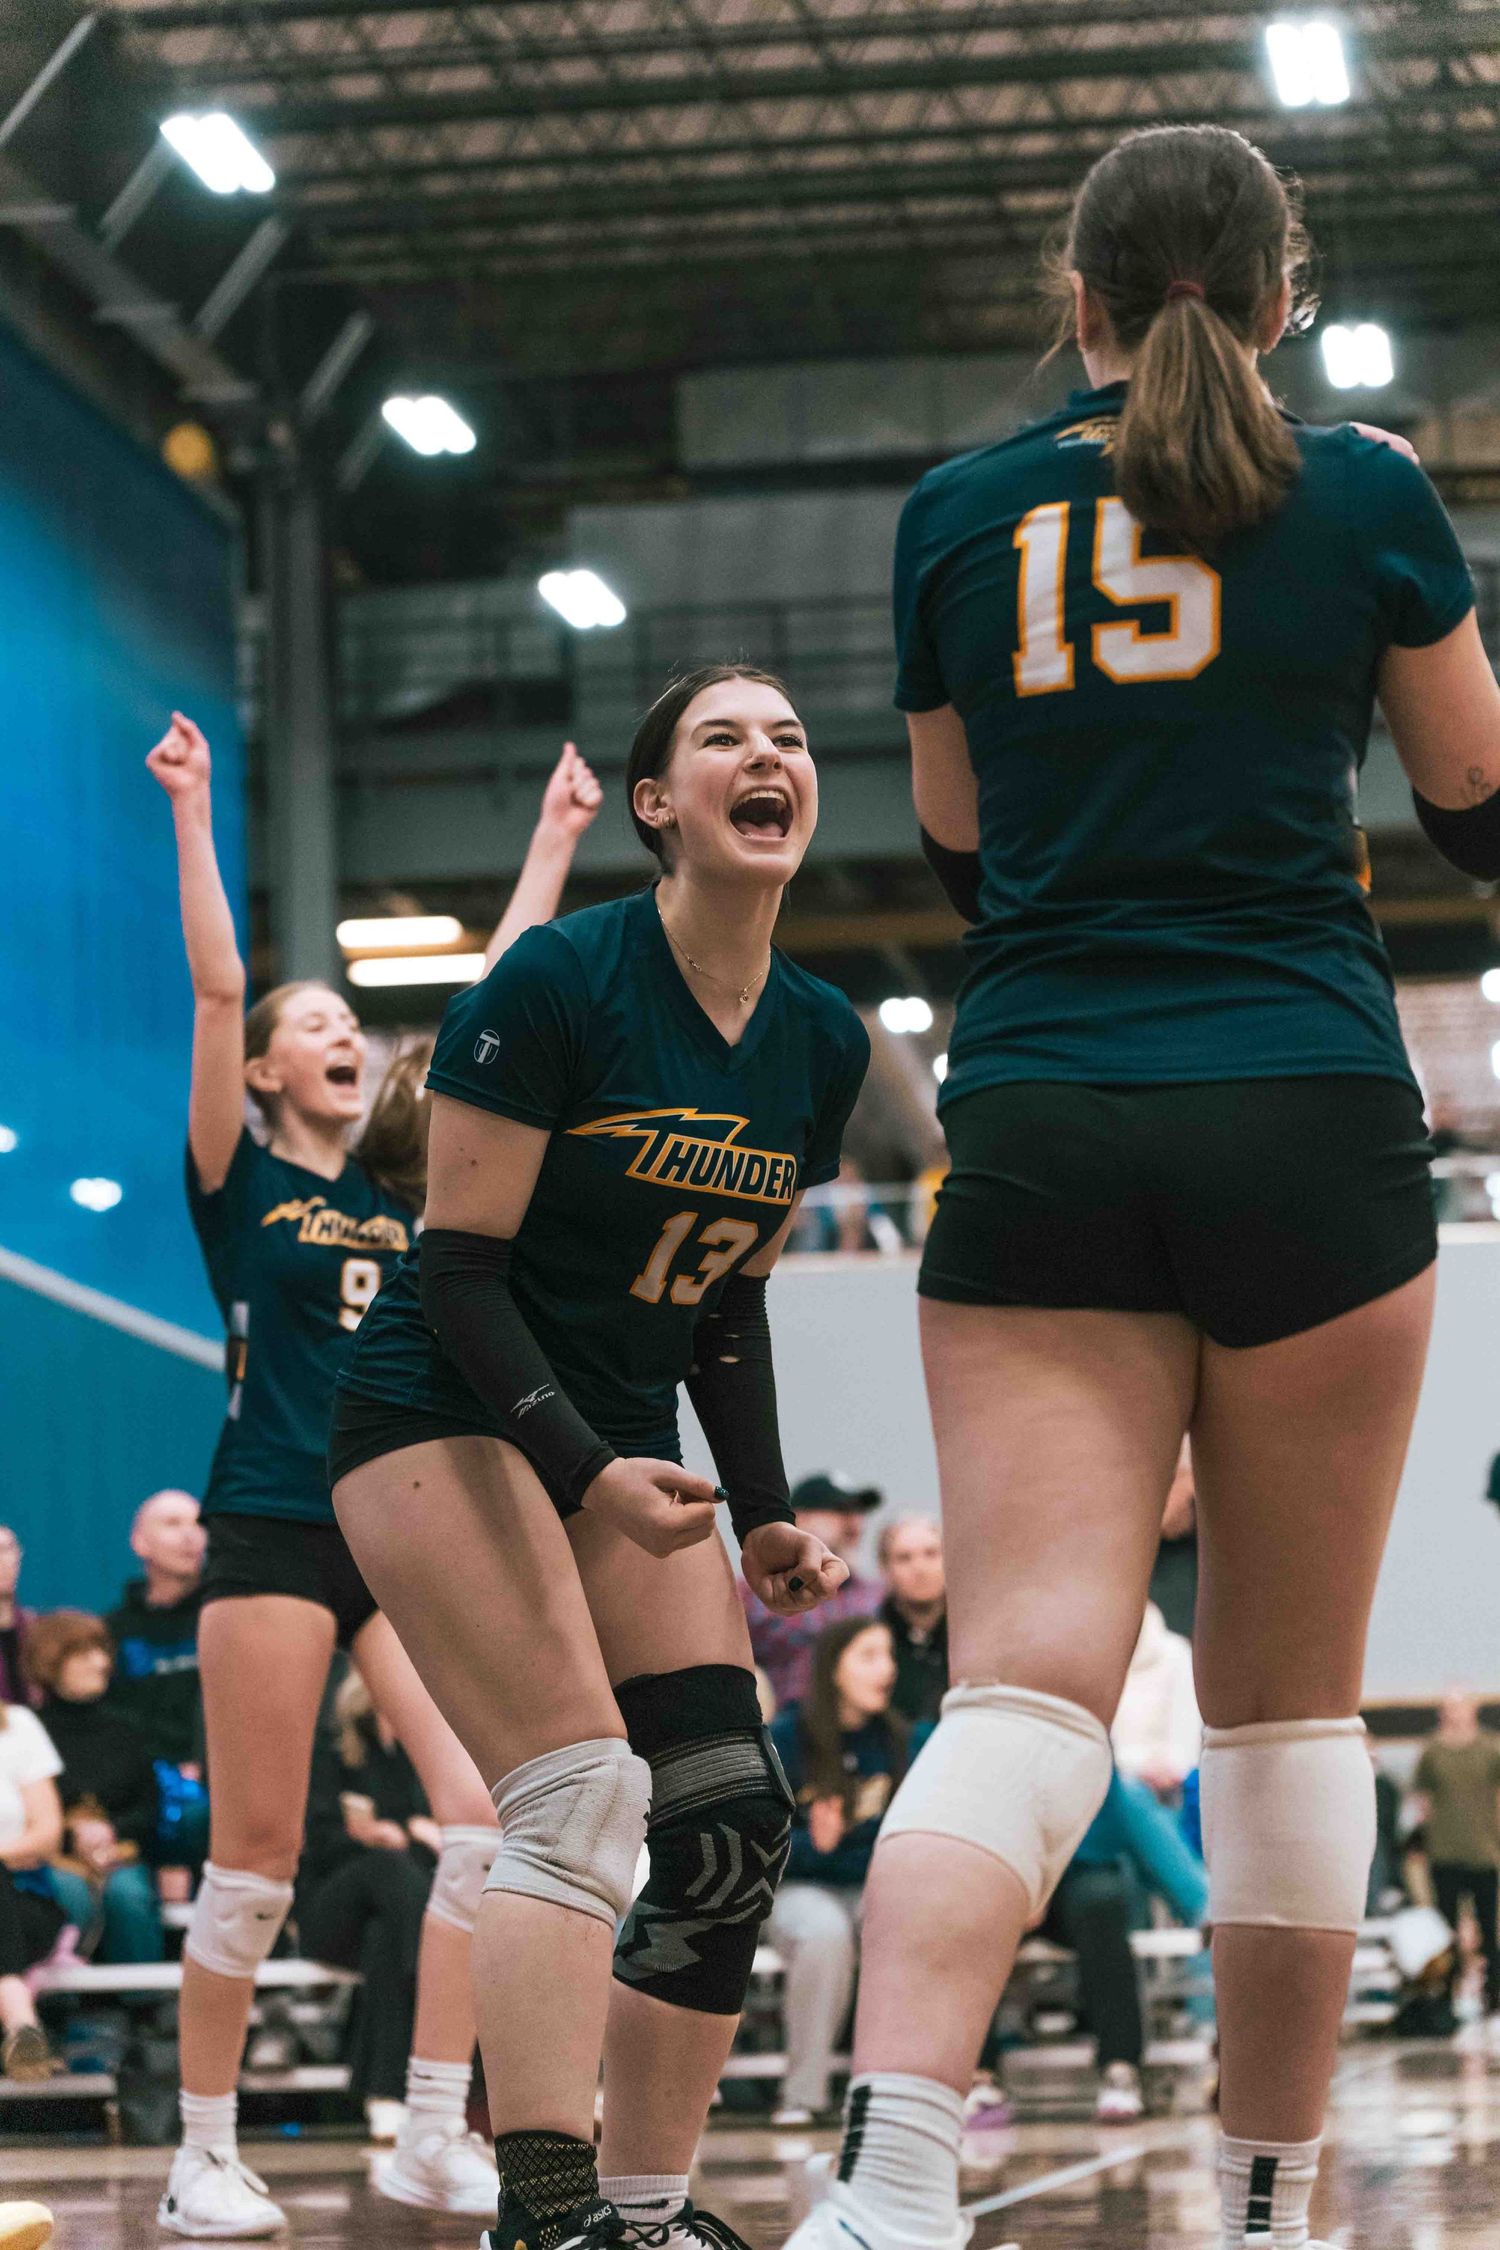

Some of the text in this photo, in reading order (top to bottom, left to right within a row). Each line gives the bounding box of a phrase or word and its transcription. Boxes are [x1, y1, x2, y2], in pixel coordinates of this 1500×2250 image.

[1012, 496, 1222, 698] 15
[588, 1109, 799, 1206] THUNDER
[339, 1257, 382, 1332] 9
[629, 1210, 759, 1305] 13
